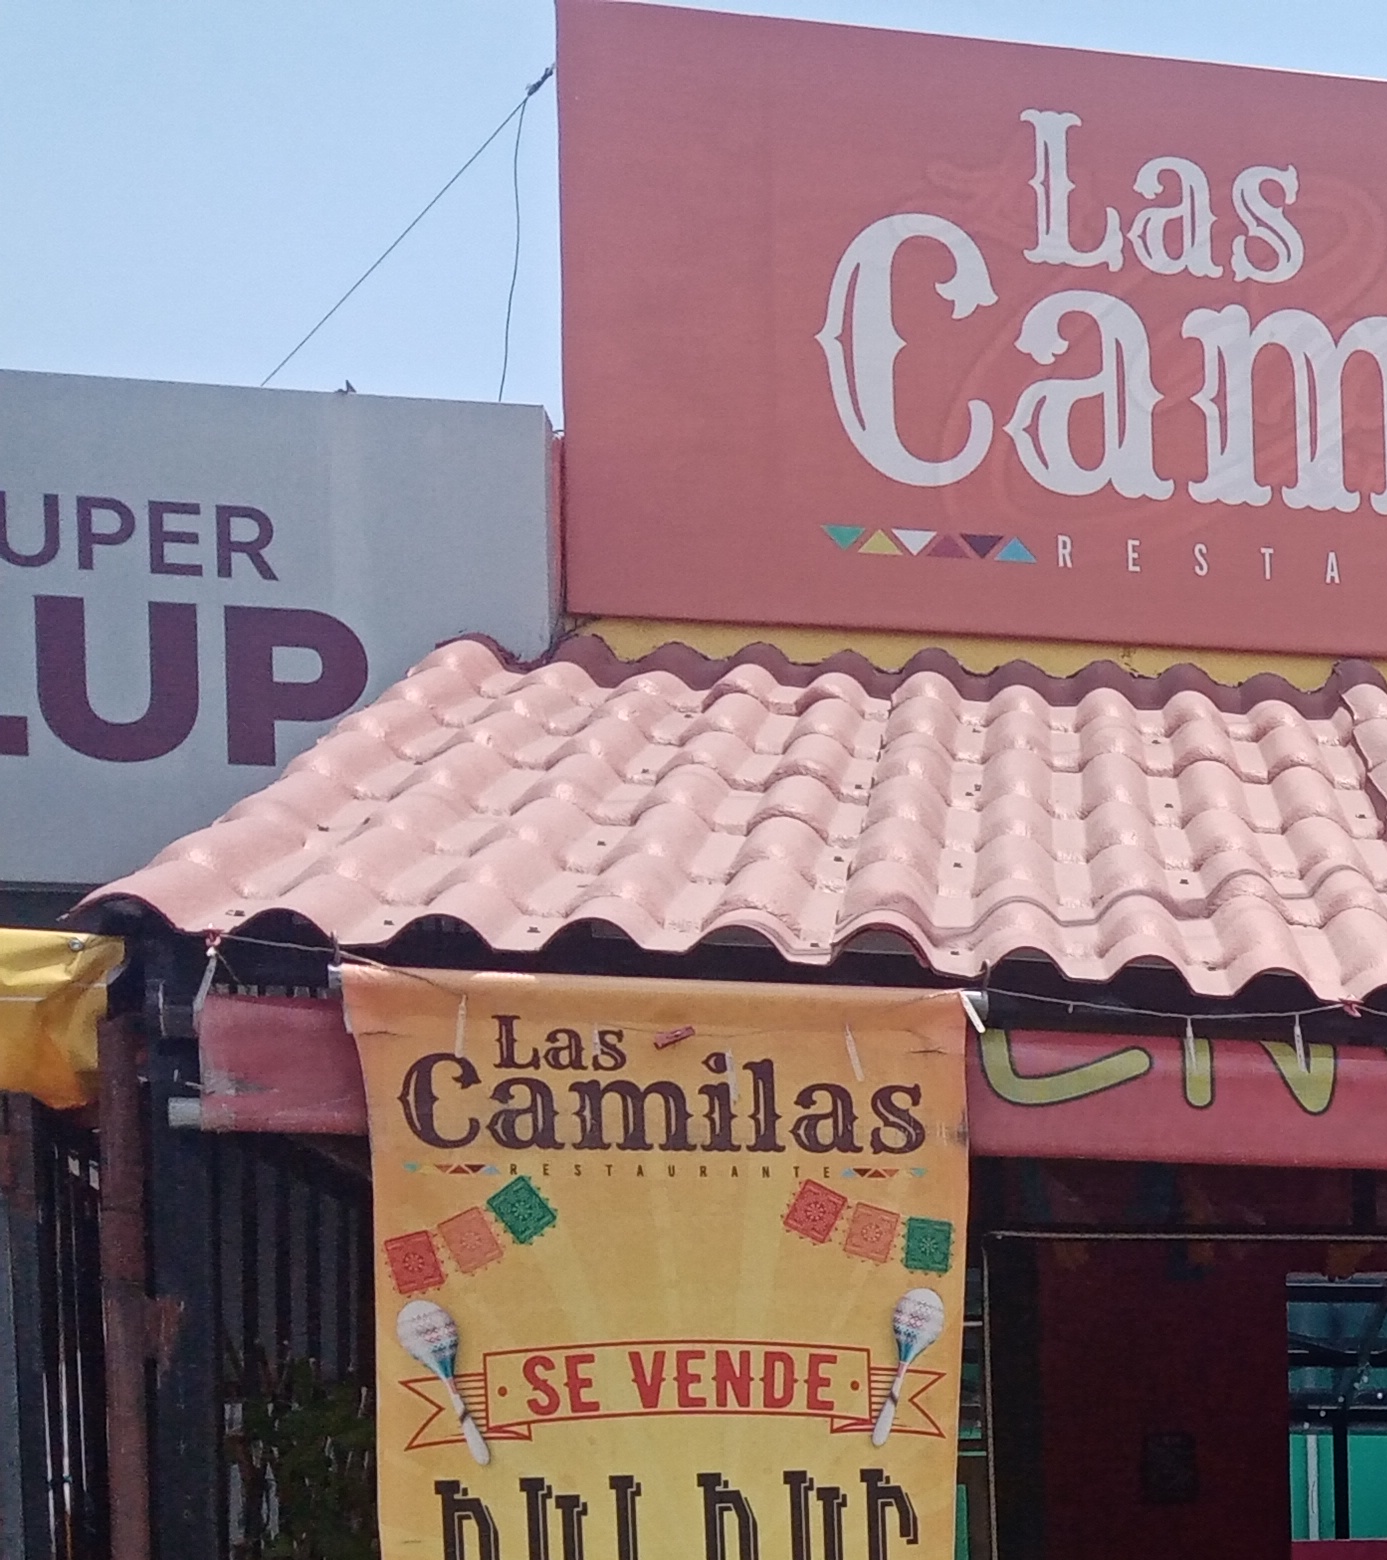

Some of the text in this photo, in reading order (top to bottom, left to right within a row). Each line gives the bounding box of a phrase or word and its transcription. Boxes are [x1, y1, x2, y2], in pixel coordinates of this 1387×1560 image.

[1017, 108, 1306, 286] Las
[491, 1014, 628, 1072] Las
[397, 1051, 927, 1156] Camilas
[509, 1162, 832, 1180] RESTAURANTE
[522, 1350, 840, 1416] SE VENDE
